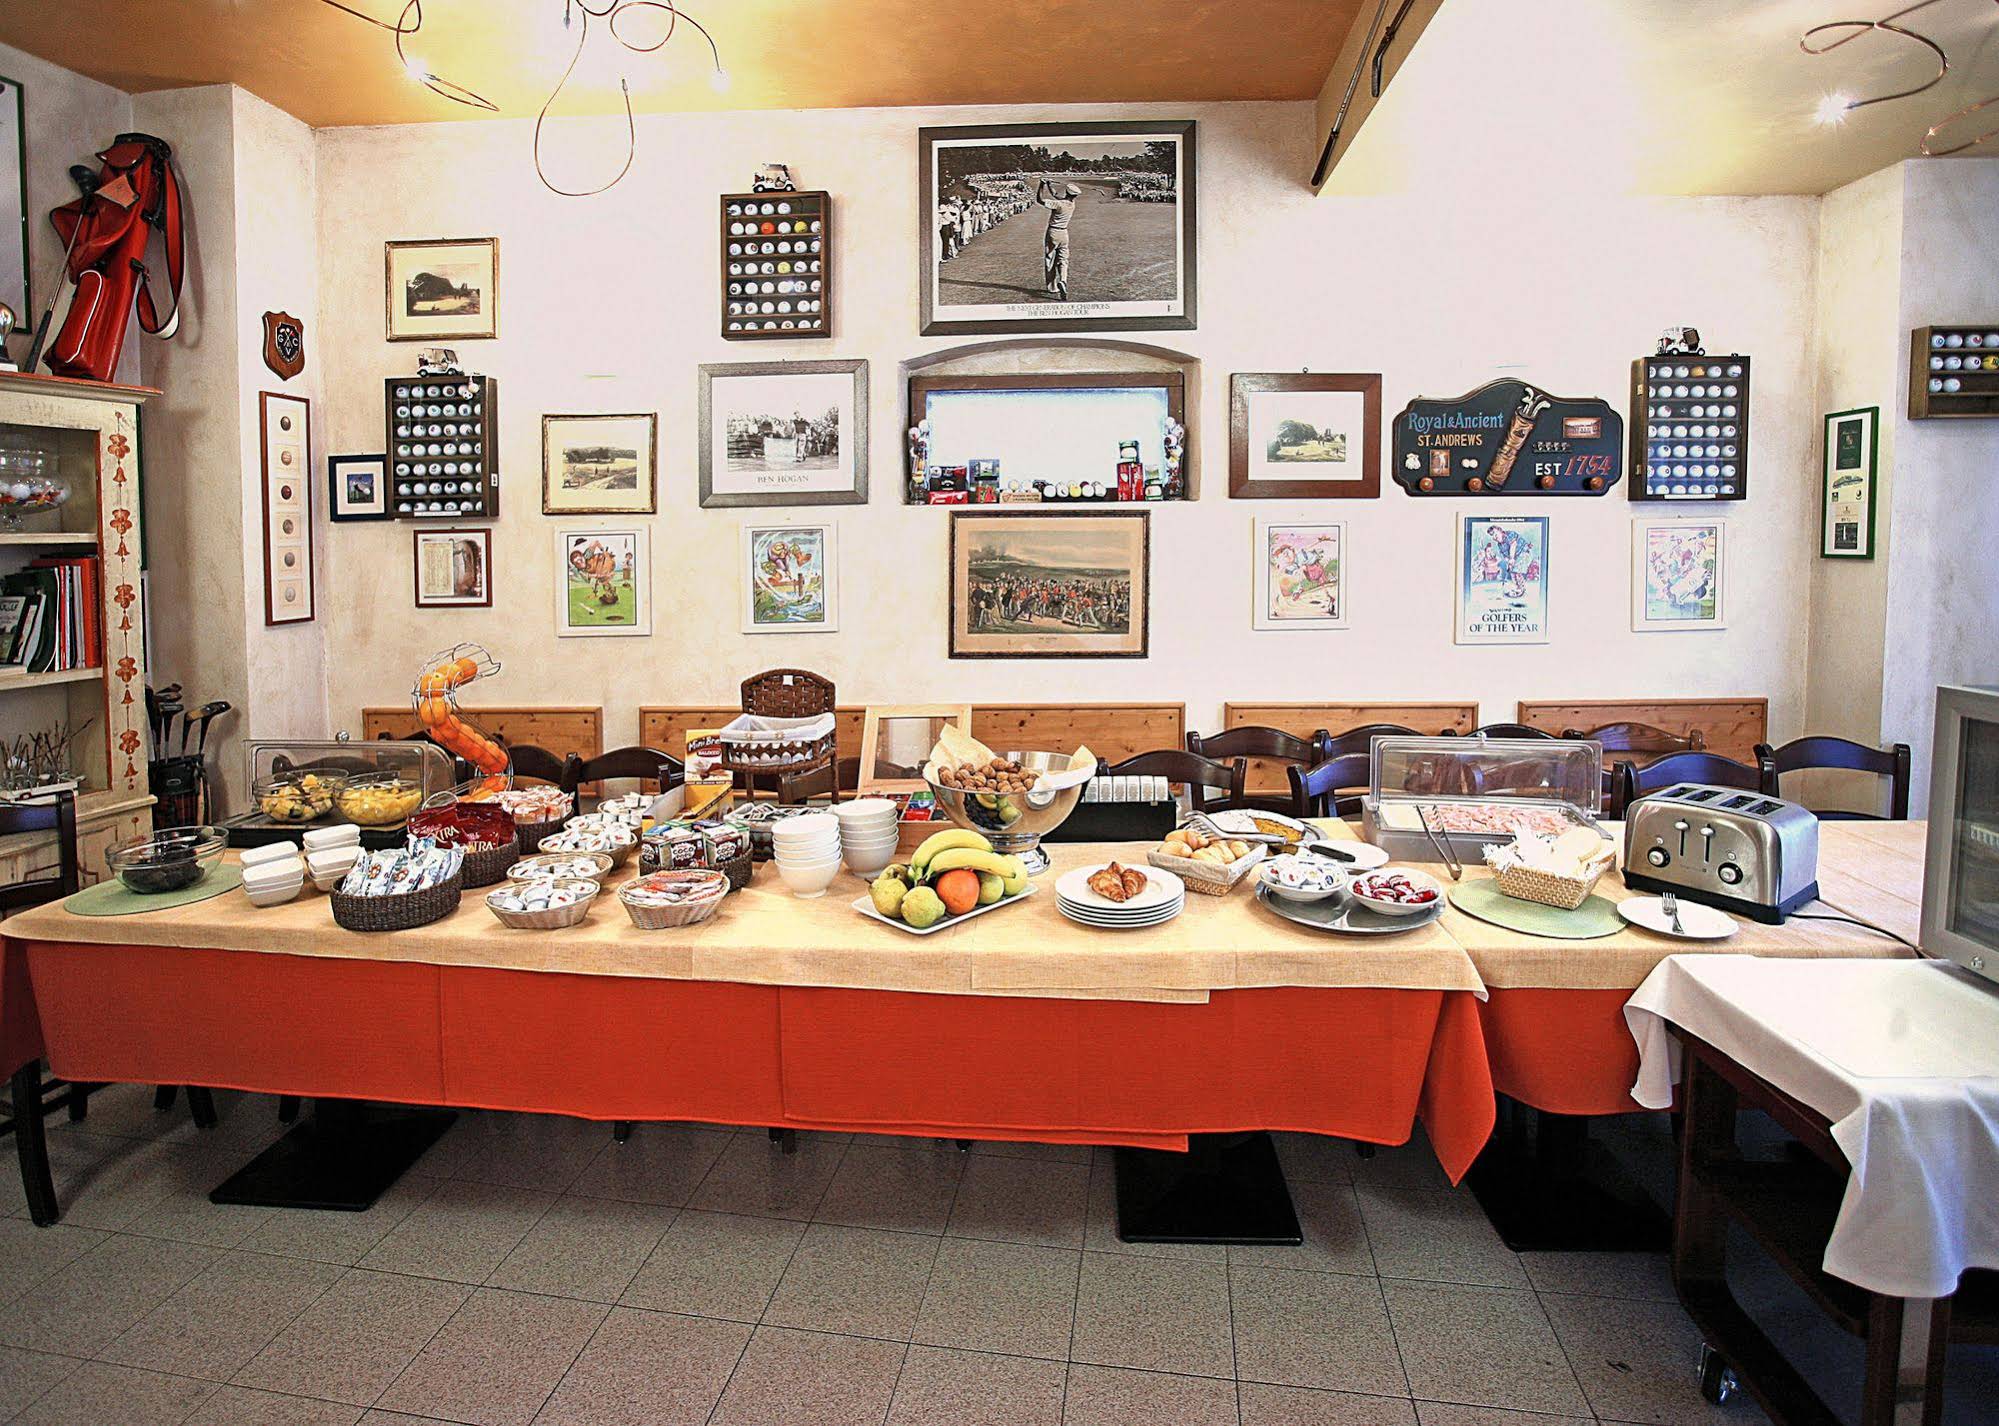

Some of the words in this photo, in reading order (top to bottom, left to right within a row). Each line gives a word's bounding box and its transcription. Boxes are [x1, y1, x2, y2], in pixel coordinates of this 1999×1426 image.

[1535, 462, 1562, 476] EST
[1564, 455, 1613, 476] 1754
[778, 475, 809, 483] HOGAN
[1481, 613, 1527, 622] GOLFERS
[1469, 624, 1482, 632] OF
[1485, 624, 1507, 632] THE
[1510, 624, 1538, 632] YEAR
[672, 846, 694, 856] COCO
[717, 845, 735, 855] COCO
